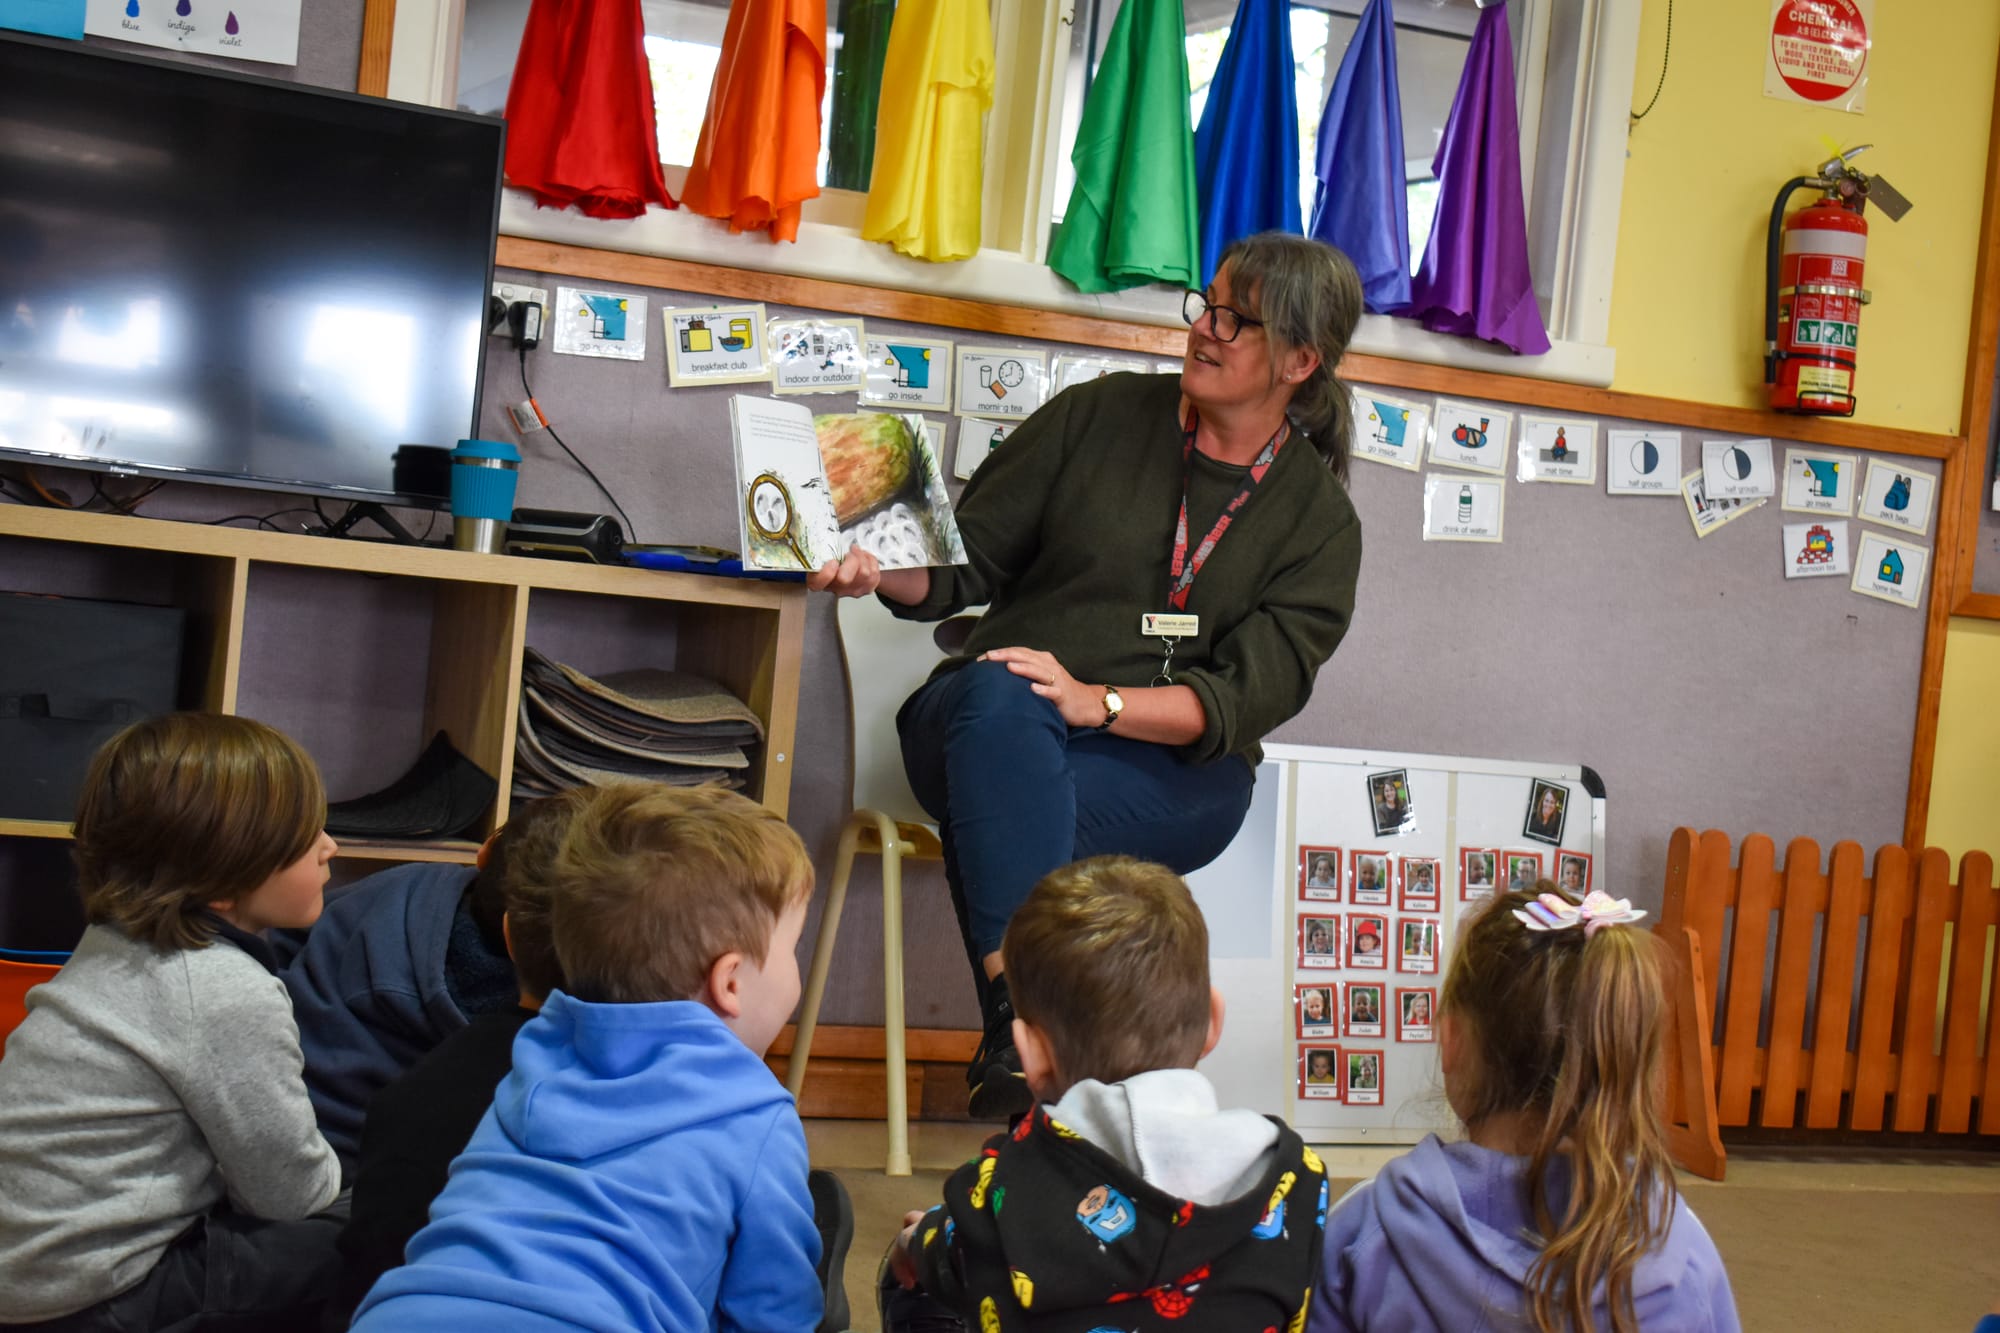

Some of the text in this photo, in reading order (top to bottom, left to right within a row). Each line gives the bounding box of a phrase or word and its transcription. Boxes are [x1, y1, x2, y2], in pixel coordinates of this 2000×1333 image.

[121, 19, 141, 32] blue
[1789, 10, 1854, 32] CHEMICAL
[167, 17, 196, 36] indigo
[219, 37, 242, 47] violet
[1780, 40, 1789, 48] TO
[1790, 41, 1798, 49] BE
[1819, 47, 1831, 56] FOR
[1802, 60, 1816, 70] AND
[1817, 62, 1855, 77] ELECTRICAL
[1807, 69, 1826, 80] FIRES
[691, 361, 748, 373] breakfast club
[785, 374, 809, 383] indoor
[823, 373, 853, 382] outdoor
[888, 392, 922, 401] go inside
[1011, 403, 1023, 412] tea
[1368, 446, 1397, 457] go inside
[1460, 453, 1477, 463] lunch
[1628, 479, 1663, 489] half groups
[1738, 486, 1759, 495] groups
[1880, 511, 1909, 524] pack bags
[1442, 526, 1488, 535] drink of water
[1796, 565, 1825, 574] afternoon
